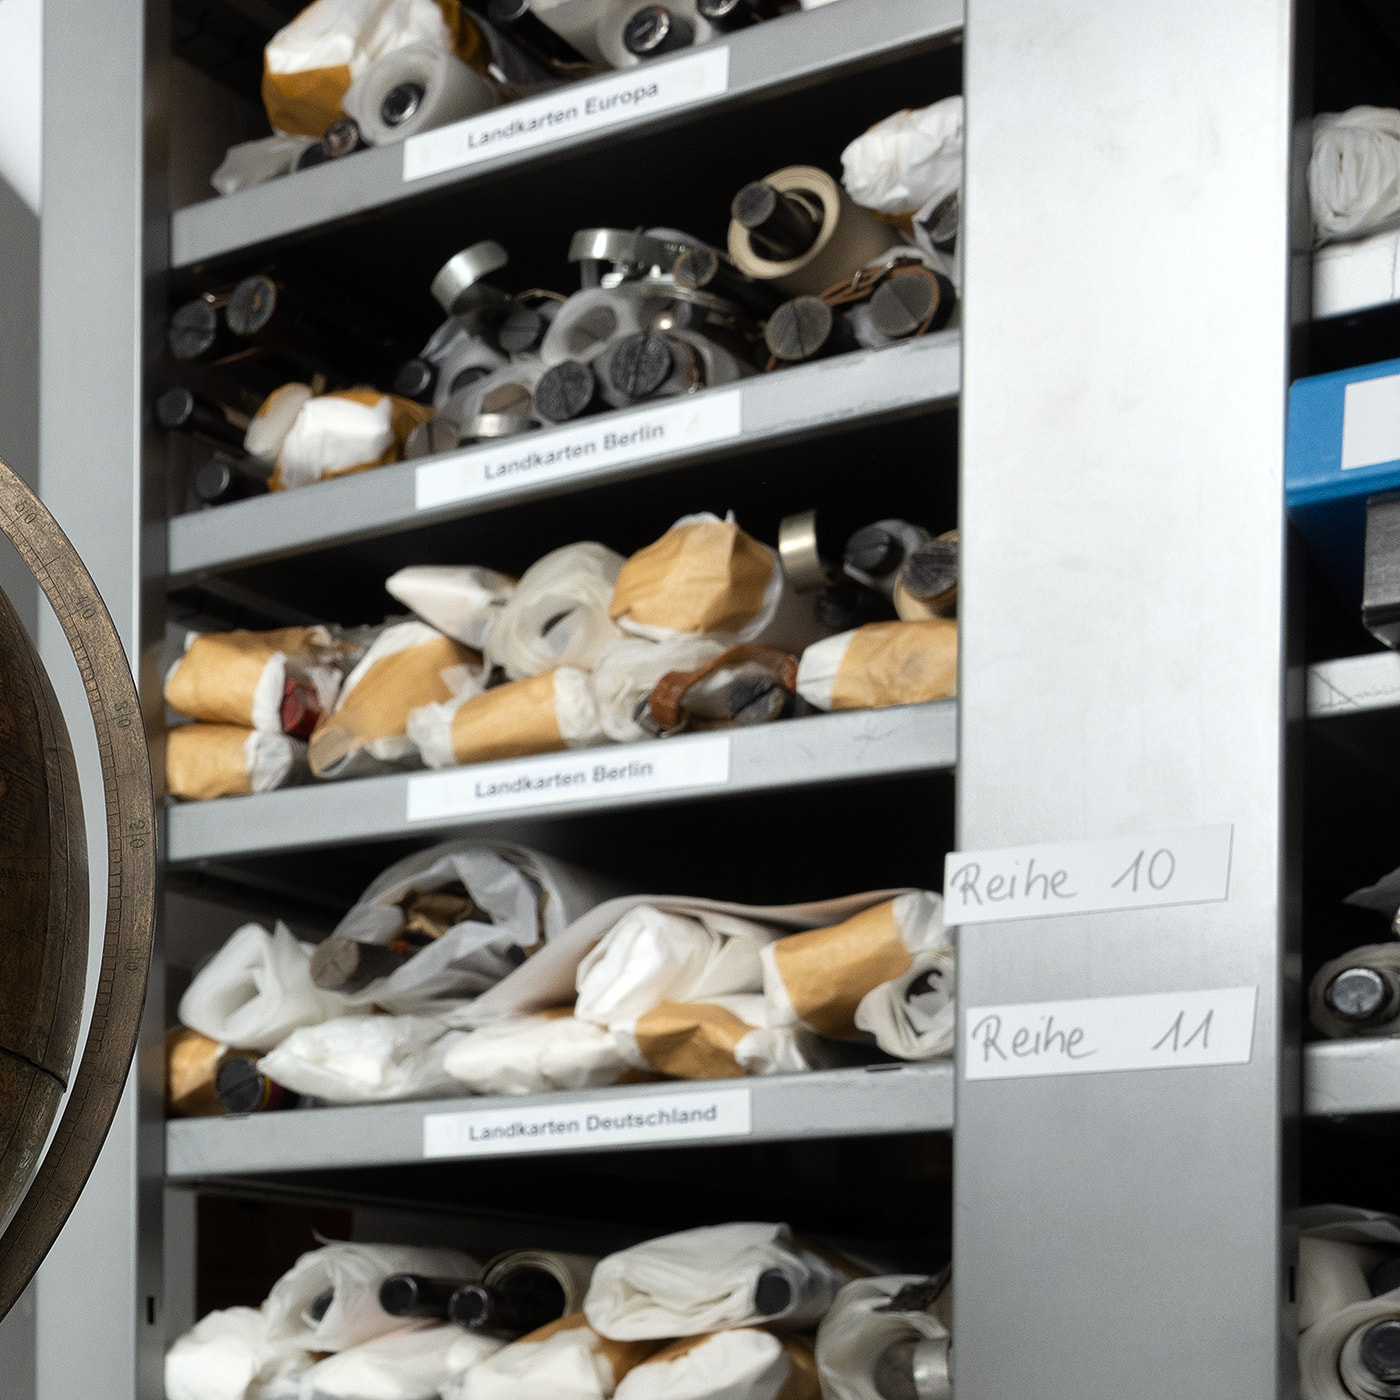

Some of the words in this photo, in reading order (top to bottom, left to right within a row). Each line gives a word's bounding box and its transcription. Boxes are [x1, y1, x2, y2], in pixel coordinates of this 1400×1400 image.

[466, 103, 579, 151] Landkarten
[585, 80, 660, 121] Europa
[482, 439, 597, 481] Landkarten
[600, 423, 666, 455] Berlin
[473, 767, 588, 801] Landkarten
[591, 757, 655, 785] Berlin
[950, 859, 1078, 906] Reihe
[1111, 848, 1176, 892] 10
[972, 1014, 1097, 1062] Reihe
[1152, 1009, 1214, 1052] 11
[467, 1115, 581, 1143] Landkarten
[585, 1104, 718, 1133] Deutschland
